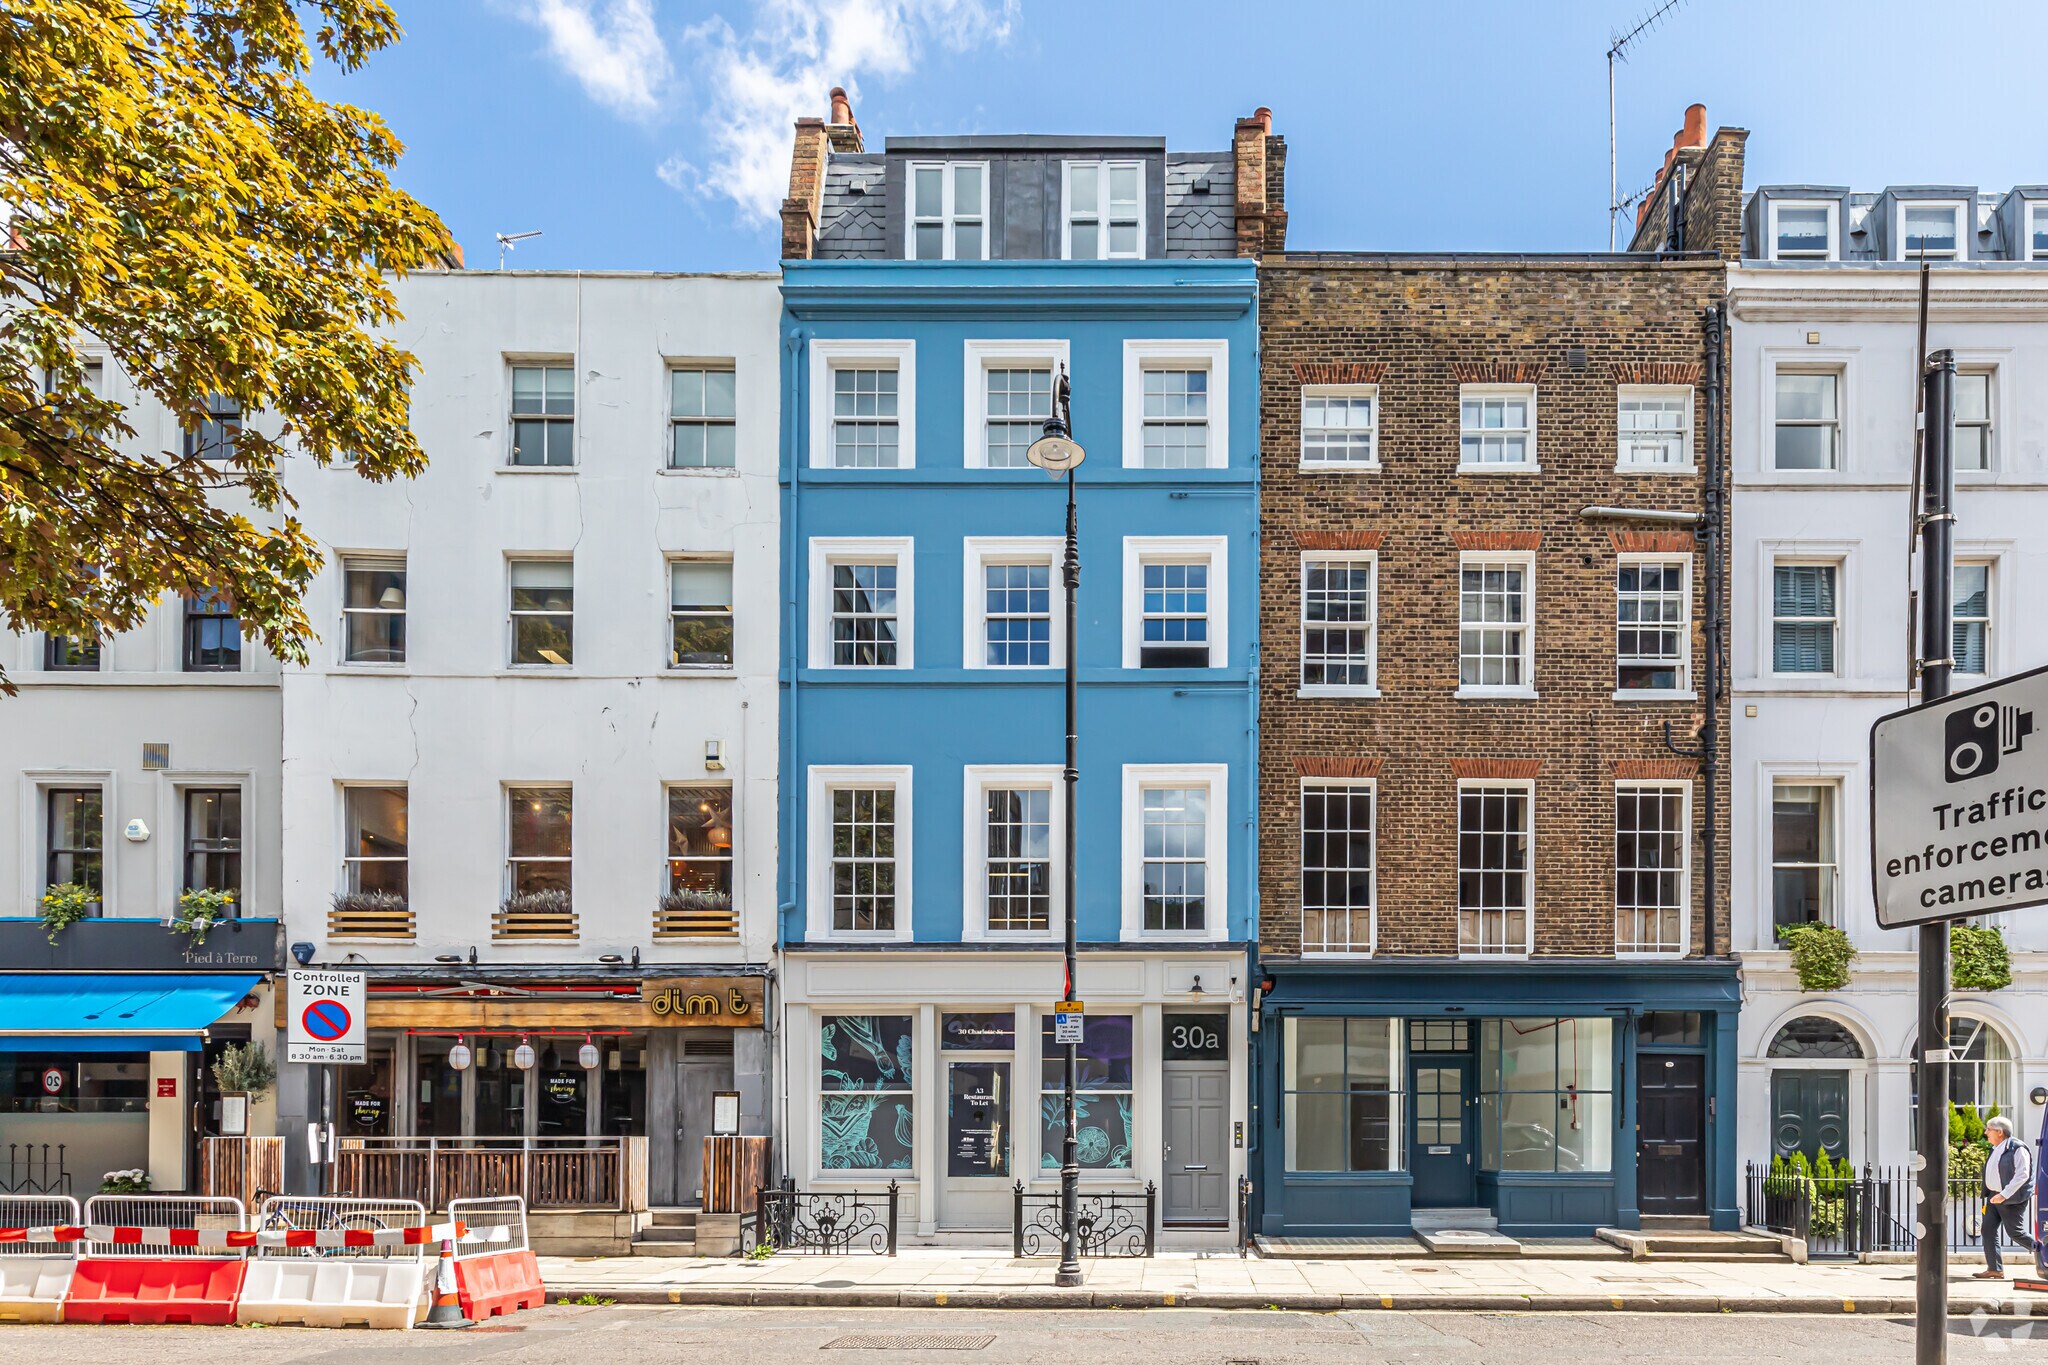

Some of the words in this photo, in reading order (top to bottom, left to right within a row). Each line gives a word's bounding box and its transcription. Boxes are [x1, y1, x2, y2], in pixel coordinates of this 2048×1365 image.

[1932, 785, 2047, 831] Traffic
[1886, 828, 2048, 878] enforcem
[1920, 868, 2048, 908] camera
[185, 951, 212, 963] Pied
[216, 952, 223, 963] à
[225, 952, 258, 963] Terre
[293, 971, 360, 983] Controlled
[303, 984, 350, 996] ZONE
[728, 988, 749, 1015] t
[1172, 1025, 1220, 1049] 30a
[550, 1084, 575, 1096] sharing
[355, 1106, 380, 1118] sharing
